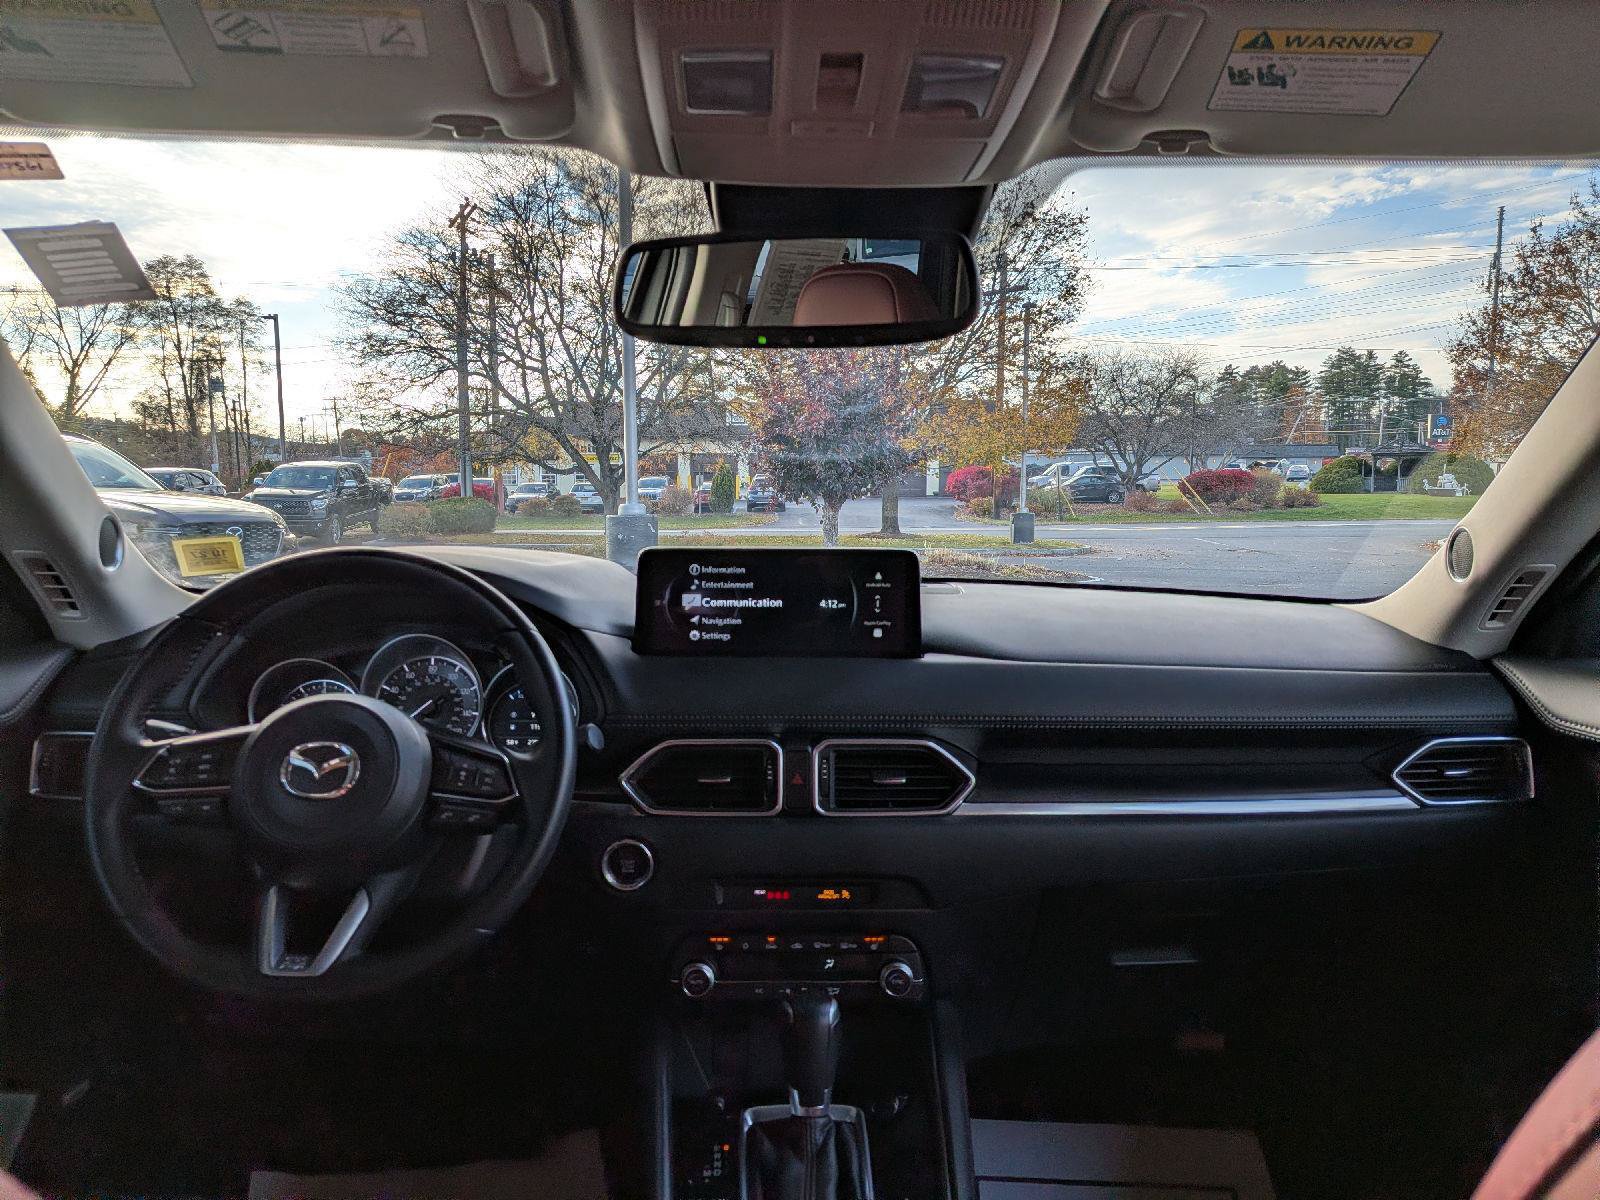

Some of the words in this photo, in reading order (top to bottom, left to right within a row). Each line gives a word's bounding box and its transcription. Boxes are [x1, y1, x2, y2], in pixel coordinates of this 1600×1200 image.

[1284, 35, 1414, 50] WARNING
[1432, 428, 1451, 436] AT&T
[702, 565, 746, 574] Information
[702, 580, 754, 589] Entertainment
[702, 597, 783, 608] Communication
[702, 616, 742, 627] Navigation
[702, 631, 731, 642] Settings
